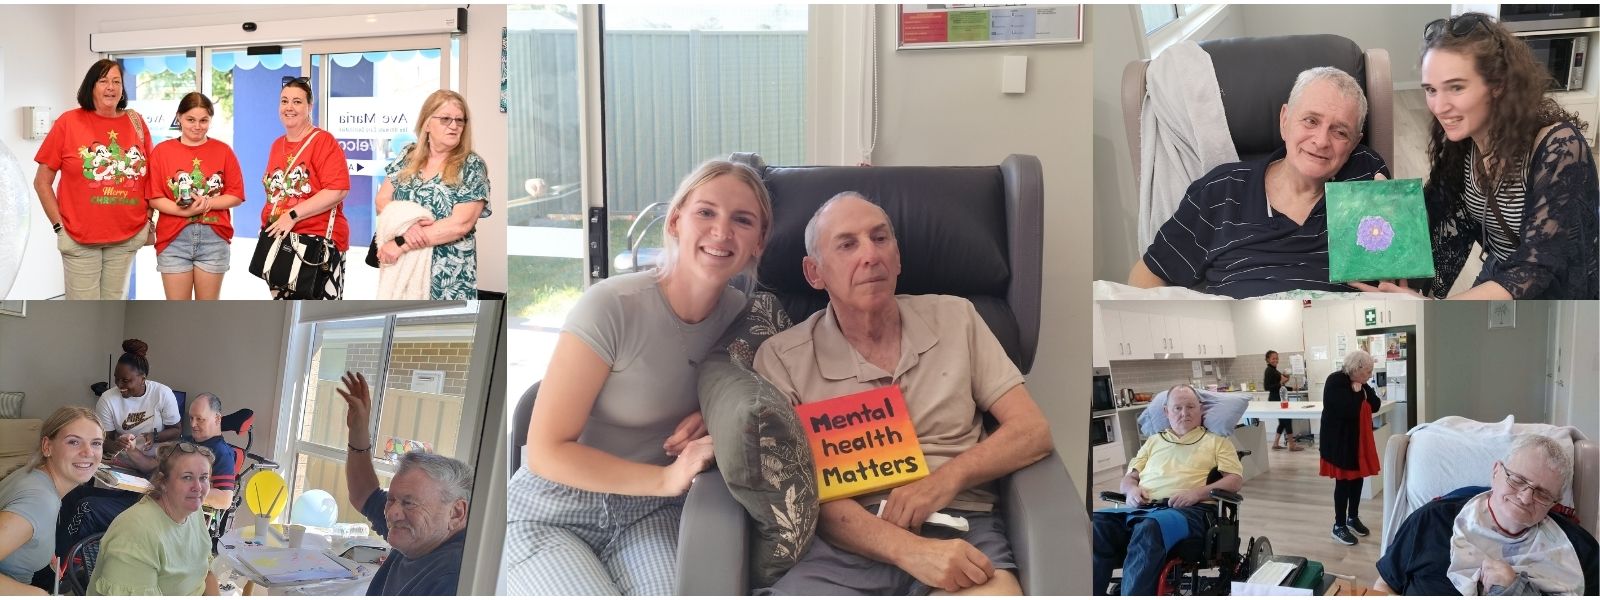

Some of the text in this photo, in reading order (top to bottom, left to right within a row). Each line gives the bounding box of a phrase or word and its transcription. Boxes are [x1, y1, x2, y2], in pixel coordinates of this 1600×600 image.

[102, 186, 129, 199] Merry
[127, 411, 146, 422] NIKE
[809, 397, 895, 433] Mental
[821, 426, 903, 457] health
[822, 456, 919, 487] Matters
